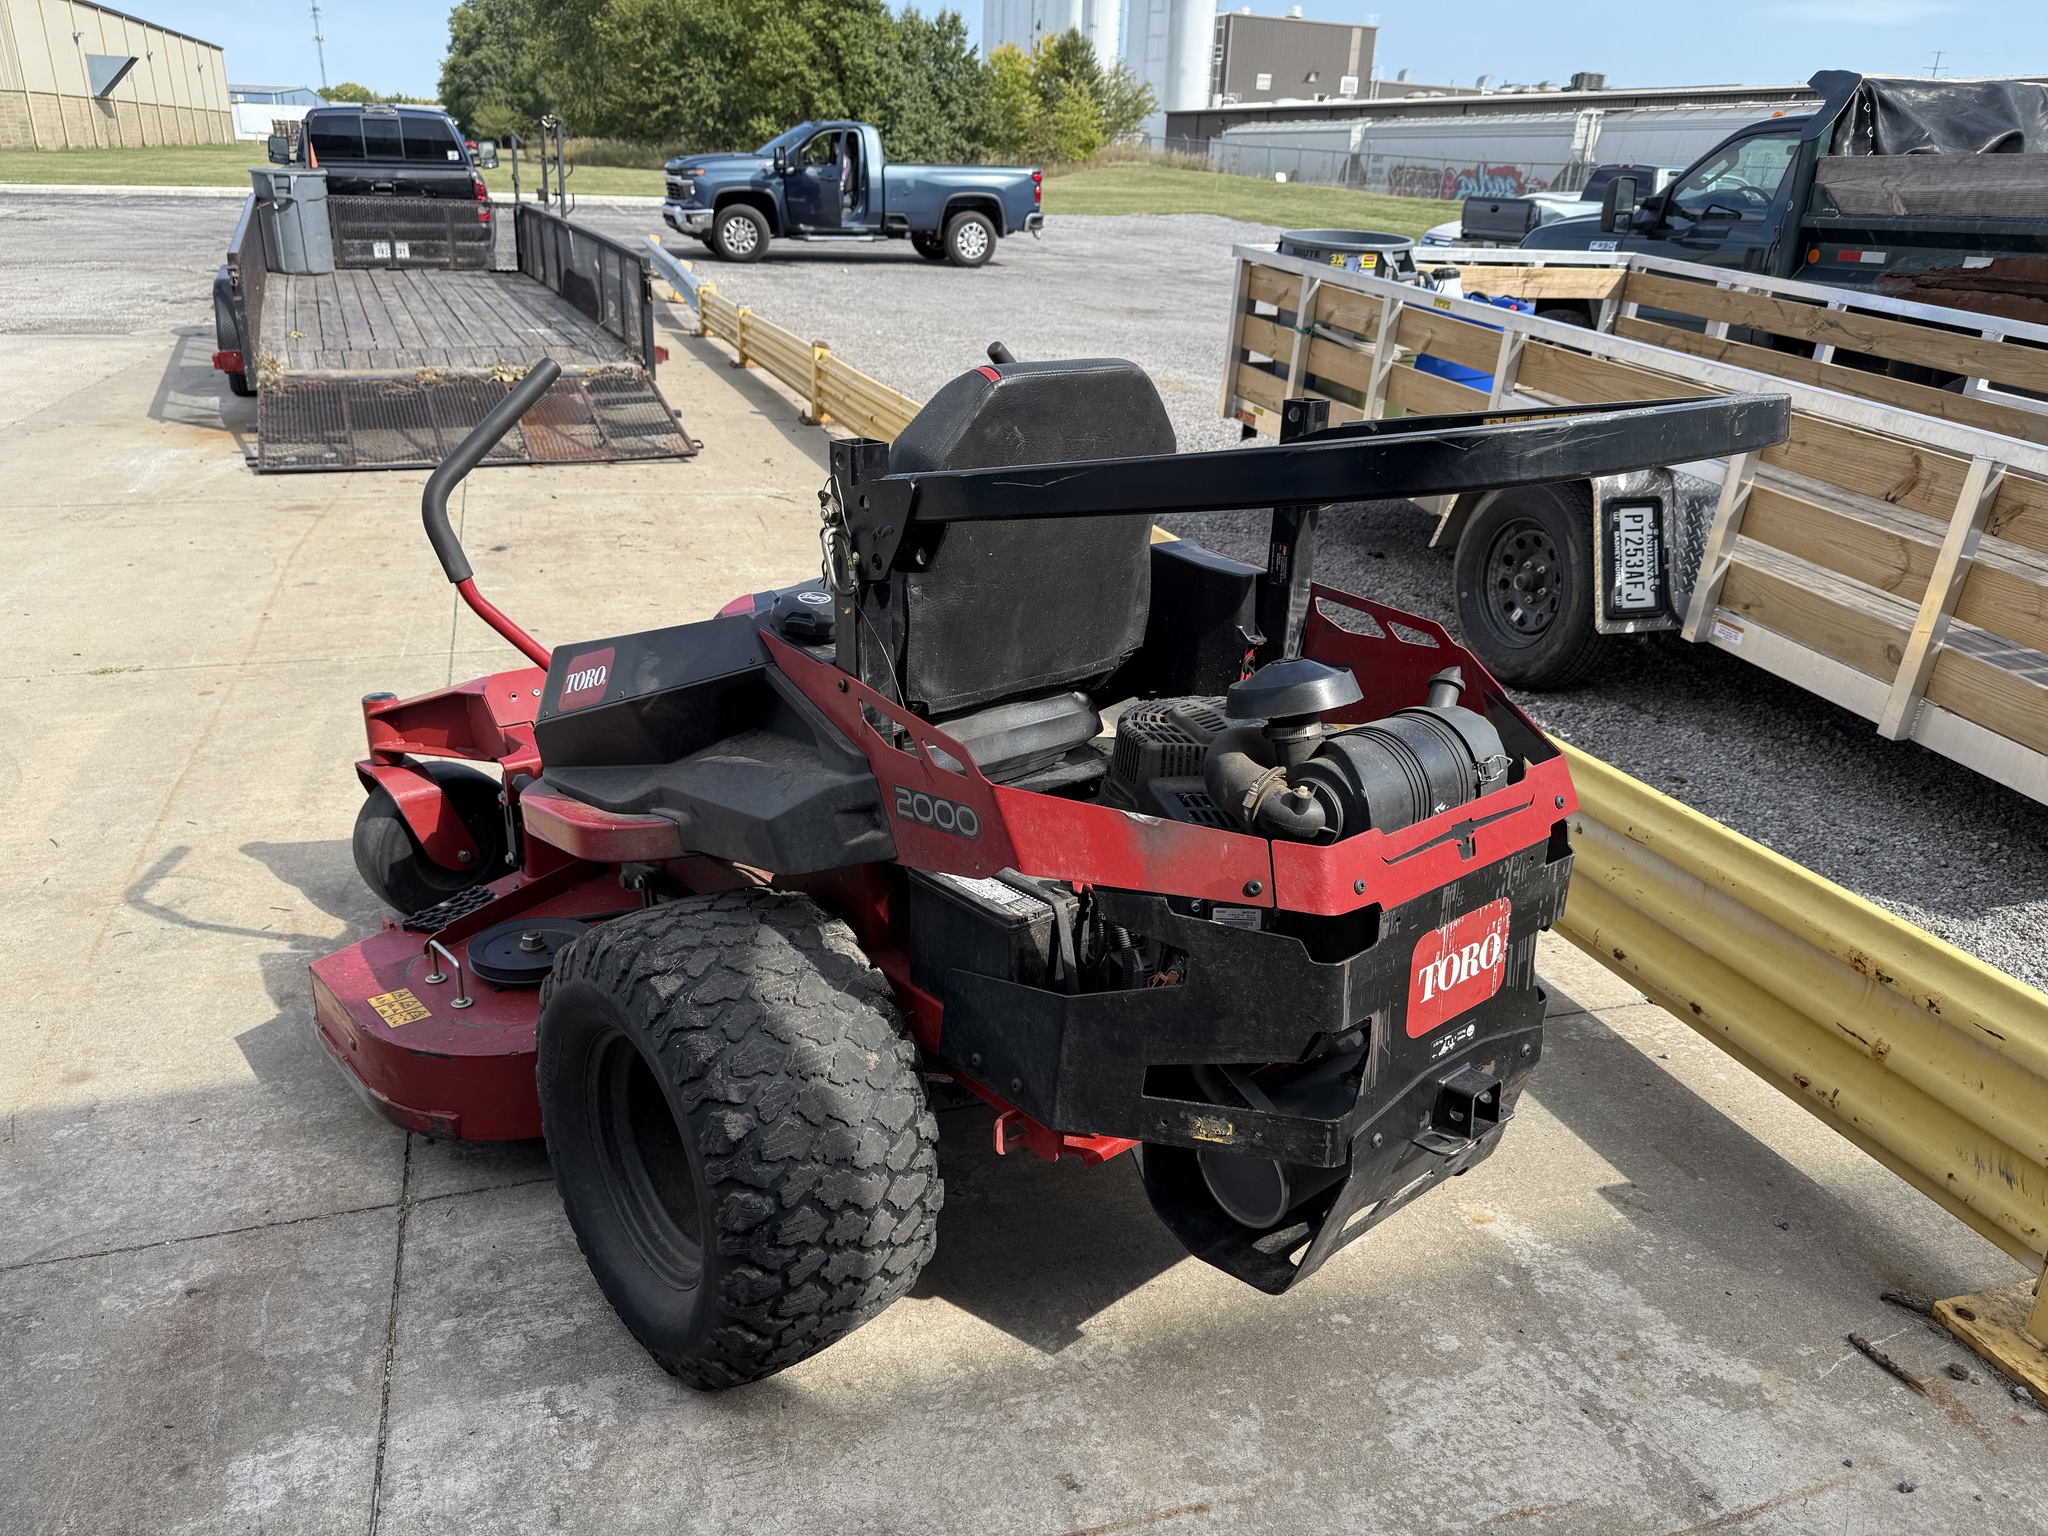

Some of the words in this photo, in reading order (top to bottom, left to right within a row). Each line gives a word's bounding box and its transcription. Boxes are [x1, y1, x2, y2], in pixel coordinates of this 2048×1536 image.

[1330, 253, 1345, 265] 3X
[1613, 530, 1622, 561] BASNEY
[1624, 514, 1646, 603] PT253AFJ
[1646, 533, 1655, 581] INDIANA
[1614, 561, 1623, 588] HONDA
[565, 665, 606, 695] TORO
[894, 786, 979, 837] 2000
[1417, 932, 1502, 1004] TORO
